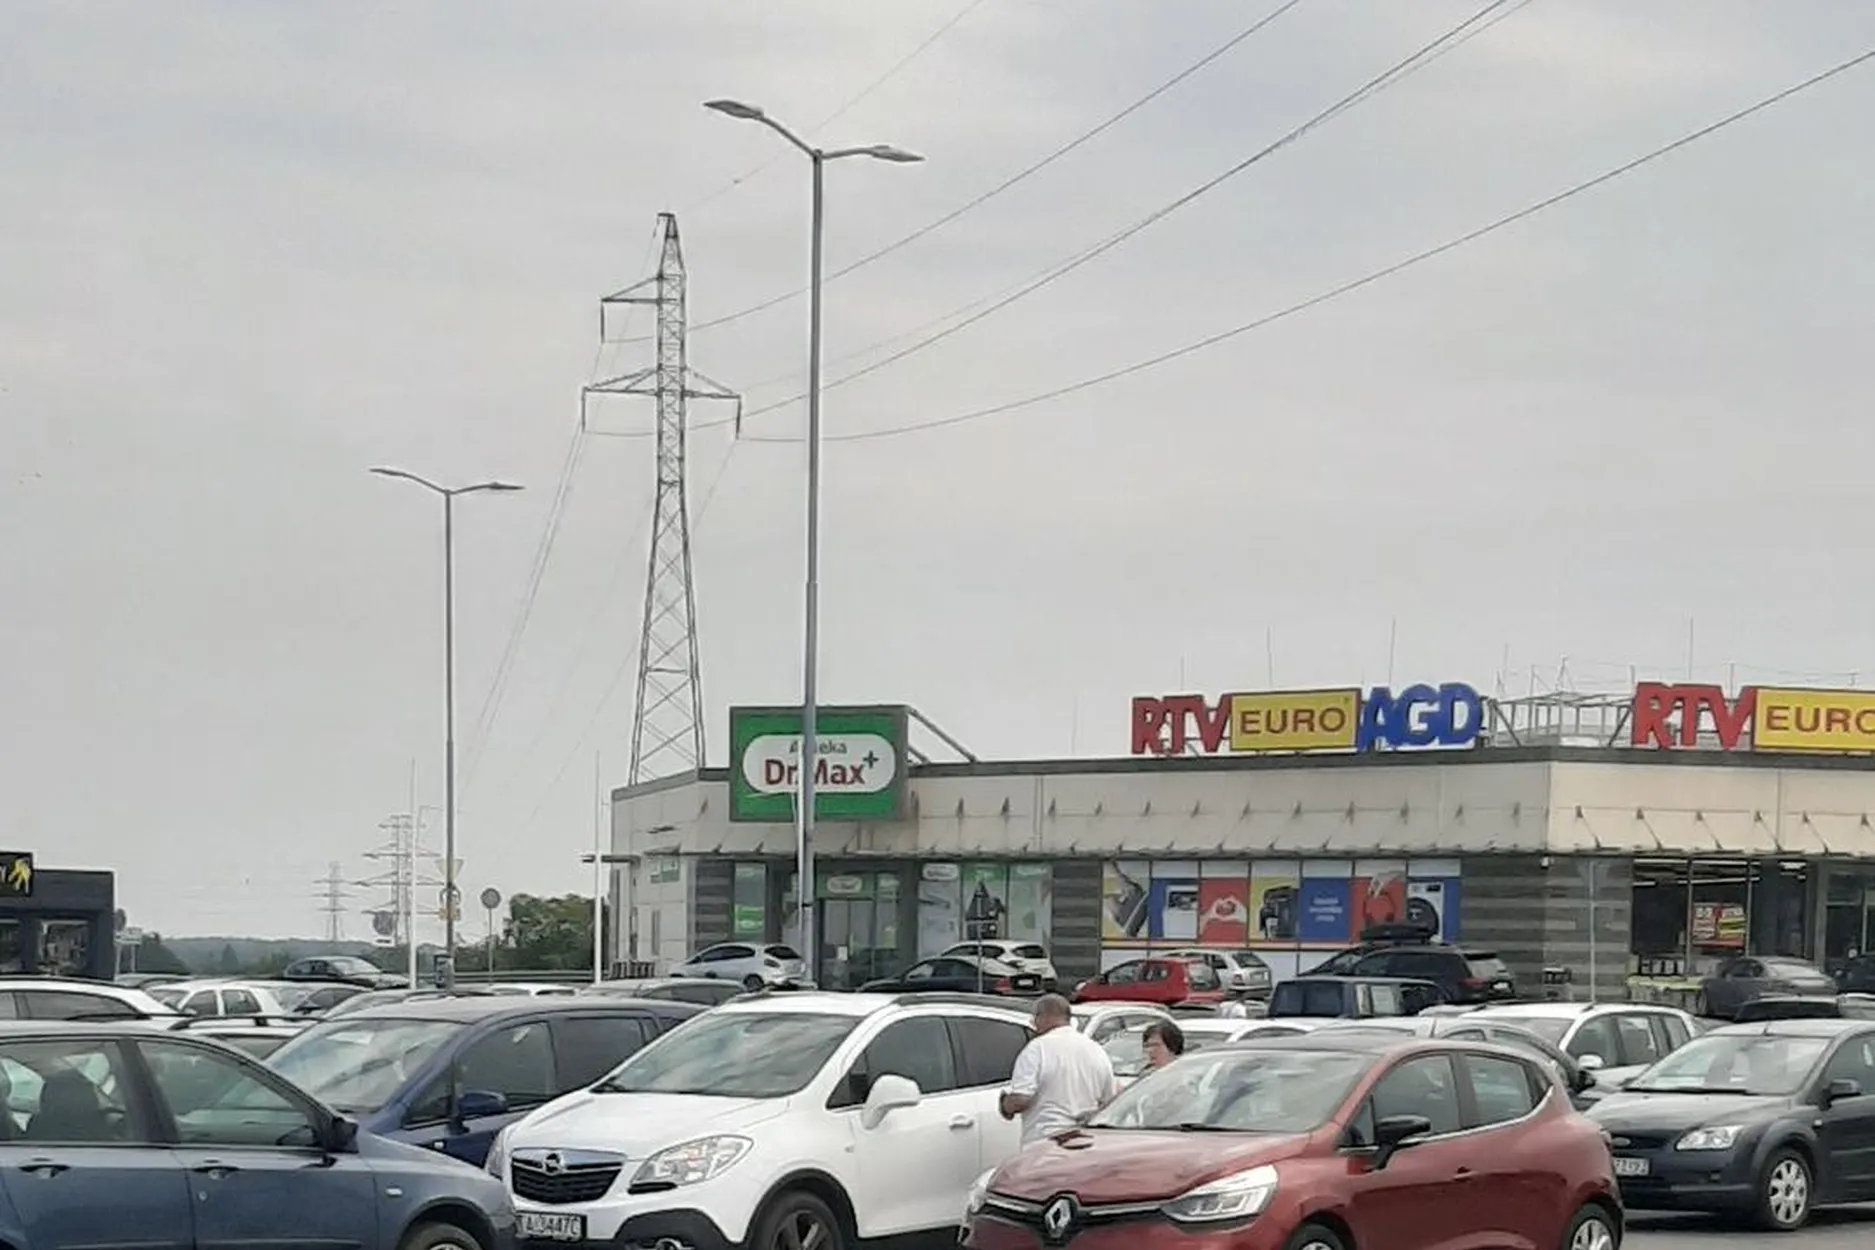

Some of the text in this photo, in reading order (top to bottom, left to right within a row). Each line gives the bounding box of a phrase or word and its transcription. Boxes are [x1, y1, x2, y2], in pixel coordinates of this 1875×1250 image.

[1132, 683, 1483, 754] RTV EURO AGD
[1632, 682, 1757, 749] RTV
